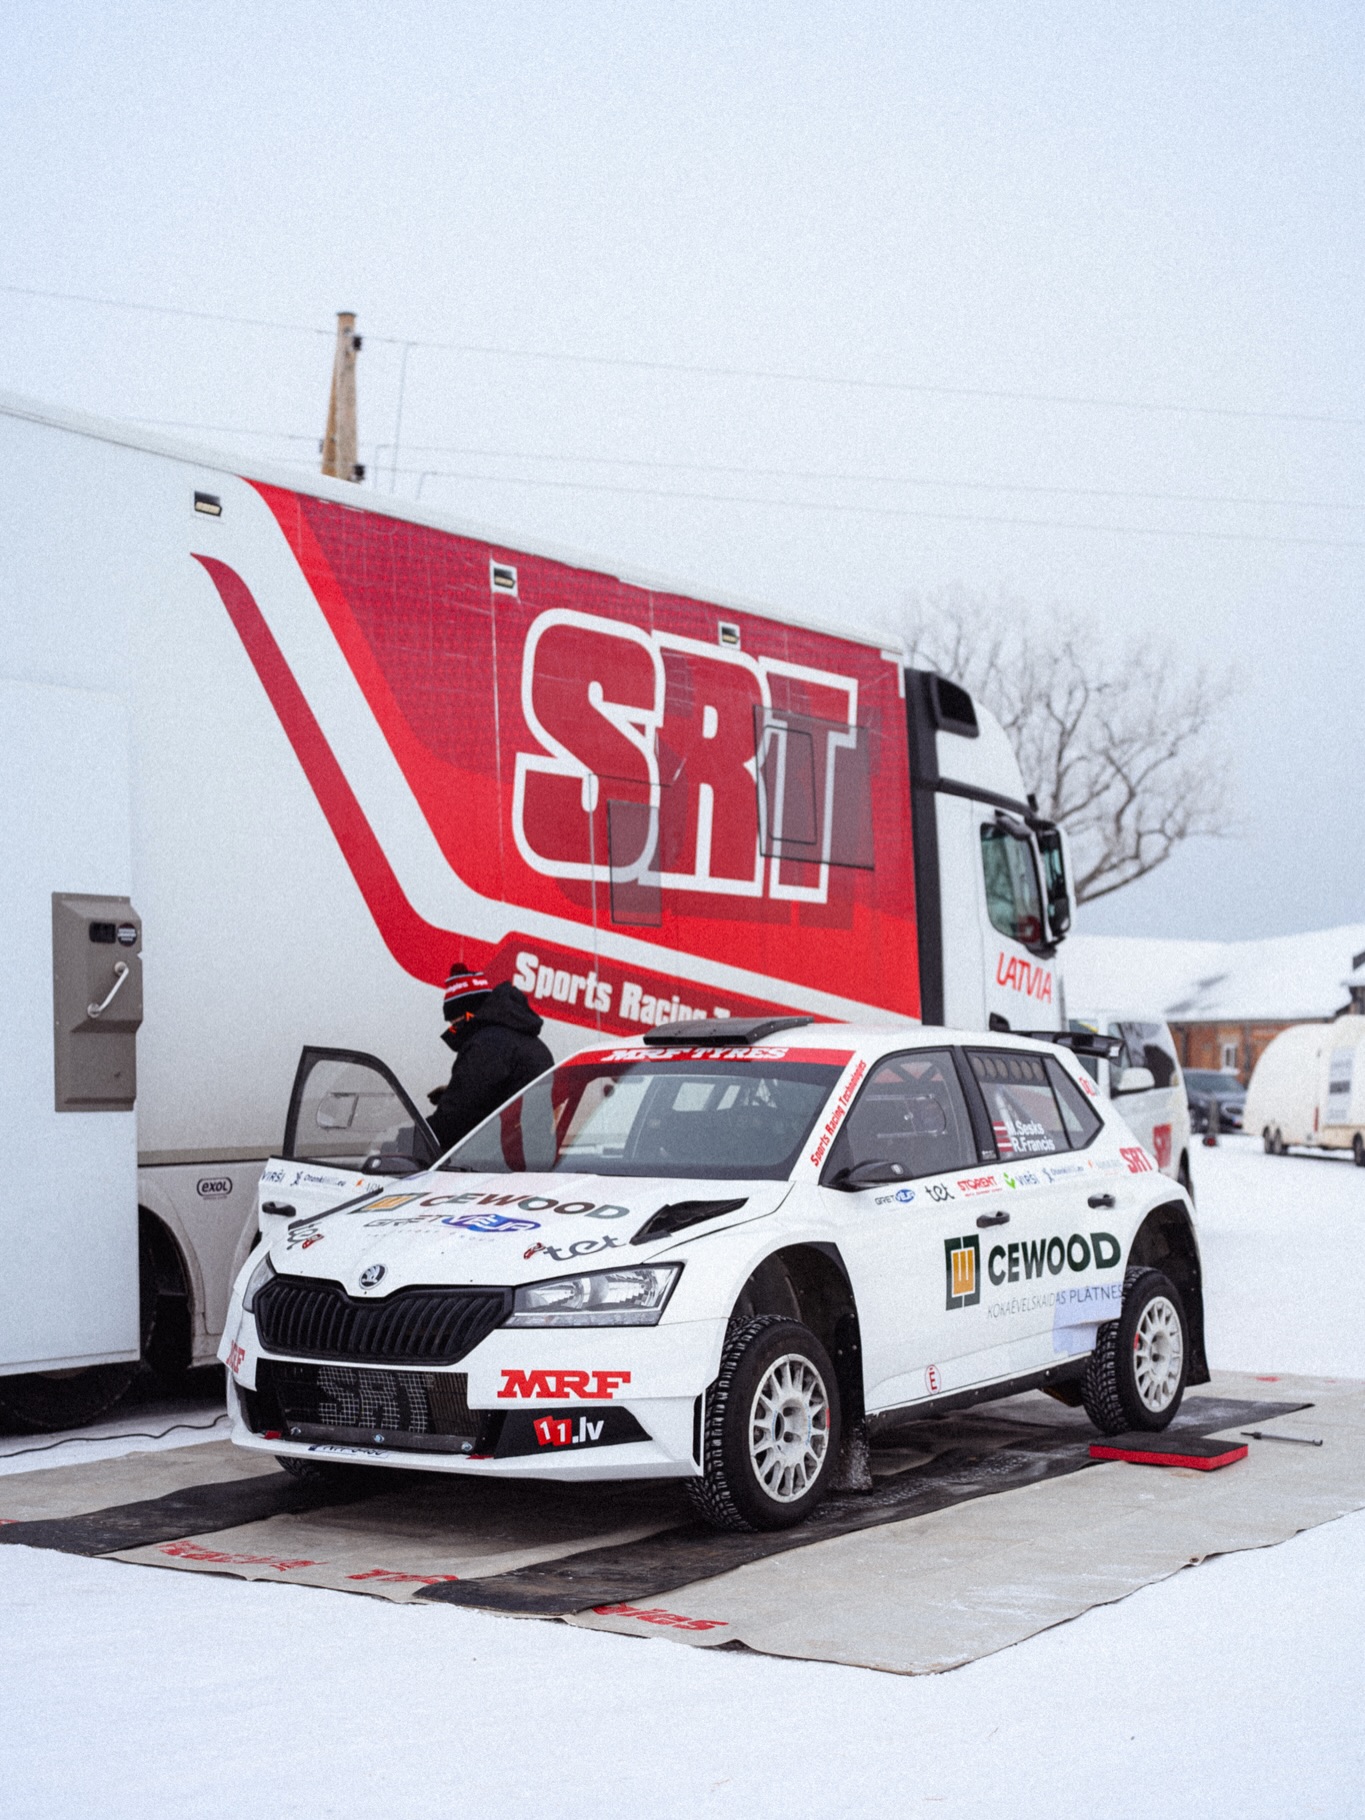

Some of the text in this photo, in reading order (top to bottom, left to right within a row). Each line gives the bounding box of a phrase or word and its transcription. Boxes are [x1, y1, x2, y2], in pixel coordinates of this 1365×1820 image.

[512, 608, 858, 904] SRT
[513, 951, 613, 1013] Sports
[996, 951, 1053, 1004] LATVIA
[600, 1046, 789, 1062] MRF TYRES
[810, 1134, 831, 1168] Sports
[824, 1105, 846, 1137] Racing
[1011, 1136, 1056, 1153] R.Francis
[1119, 1146, 1153, 1174] SRT
[419, 1192, 630, 1220] CEWOOD
[925, 1182, 956, 1203] tet
[543, 1235, 627, 1261] tet
[988, 1231, 1122, 1287] CEWOOD
[497, 1370, 631, 1399] MRF
[317, 1366, 434, 1433] SRT
[539, 1416, 604, 1444] 11.lv
